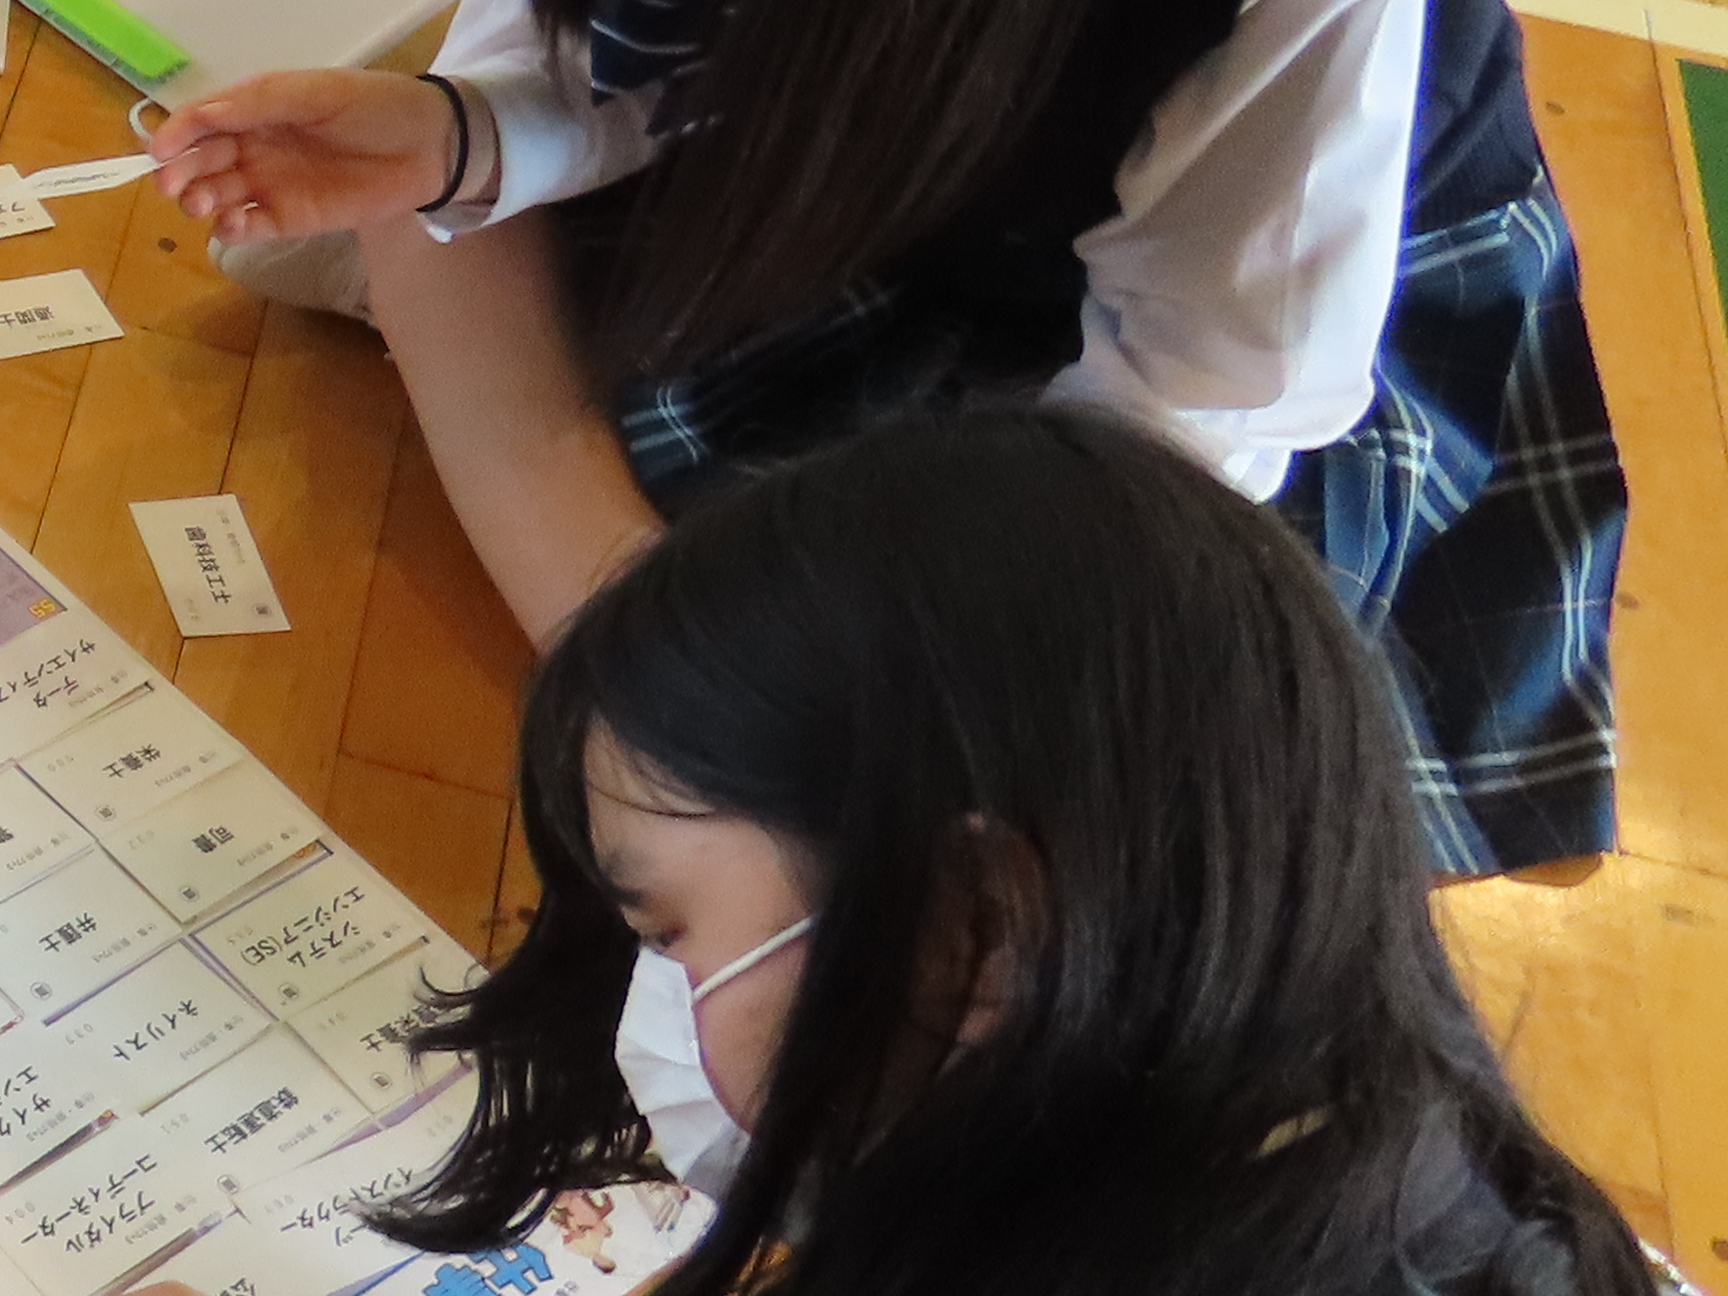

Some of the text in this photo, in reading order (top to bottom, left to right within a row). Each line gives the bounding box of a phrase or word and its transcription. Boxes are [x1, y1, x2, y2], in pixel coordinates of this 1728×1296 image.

[33, 676, 78, 707] データ
[102, 744, 160, 777] 栄養士
[192, 826, 233, 853] 司書
[39, 913, 95, 951] 弁護士
[287, 921, 359, 967] システム
[113, 999, 197, 1060] ネイリスト
[204, 1087, 297, 1152] 鉄道運転士
[21, 1154, 156, 1243] コーディネーター
[66, 1191, 154, 1252] ブライダル
